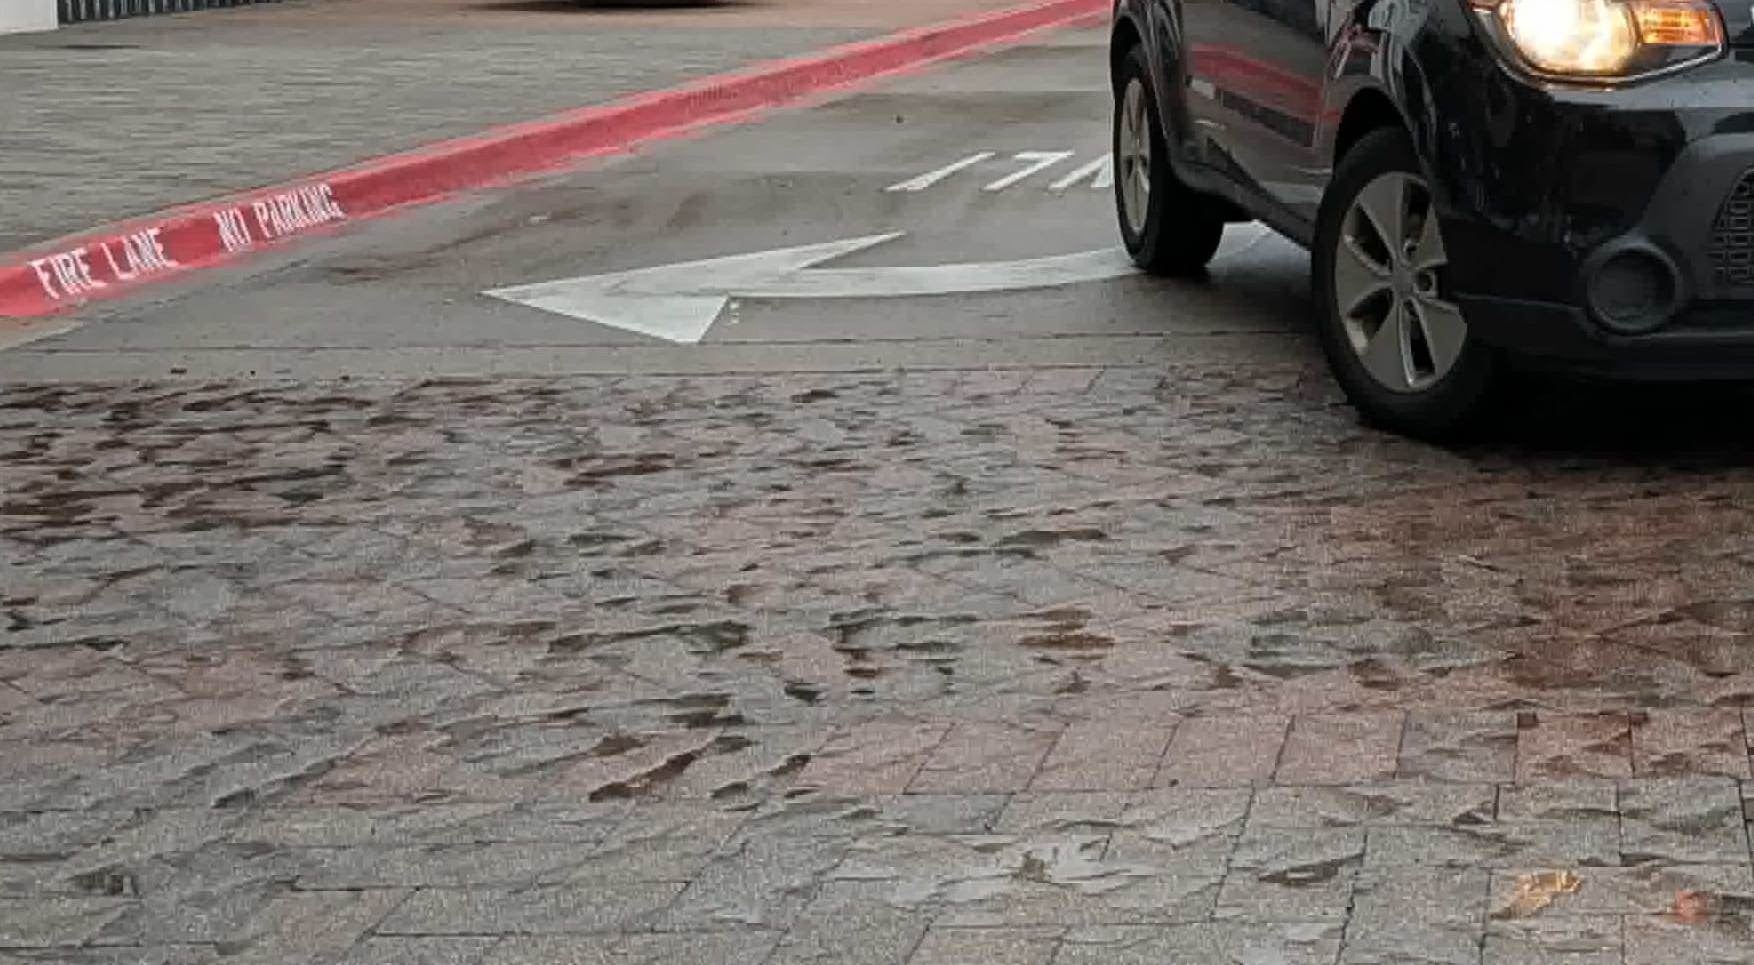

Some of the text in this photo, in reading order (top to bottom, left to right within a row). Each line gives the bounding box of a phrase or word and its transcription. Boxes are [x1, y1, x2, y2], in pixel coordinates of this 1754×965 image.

[28, 183, 346, 299] FIRE LANE NO PARKING
